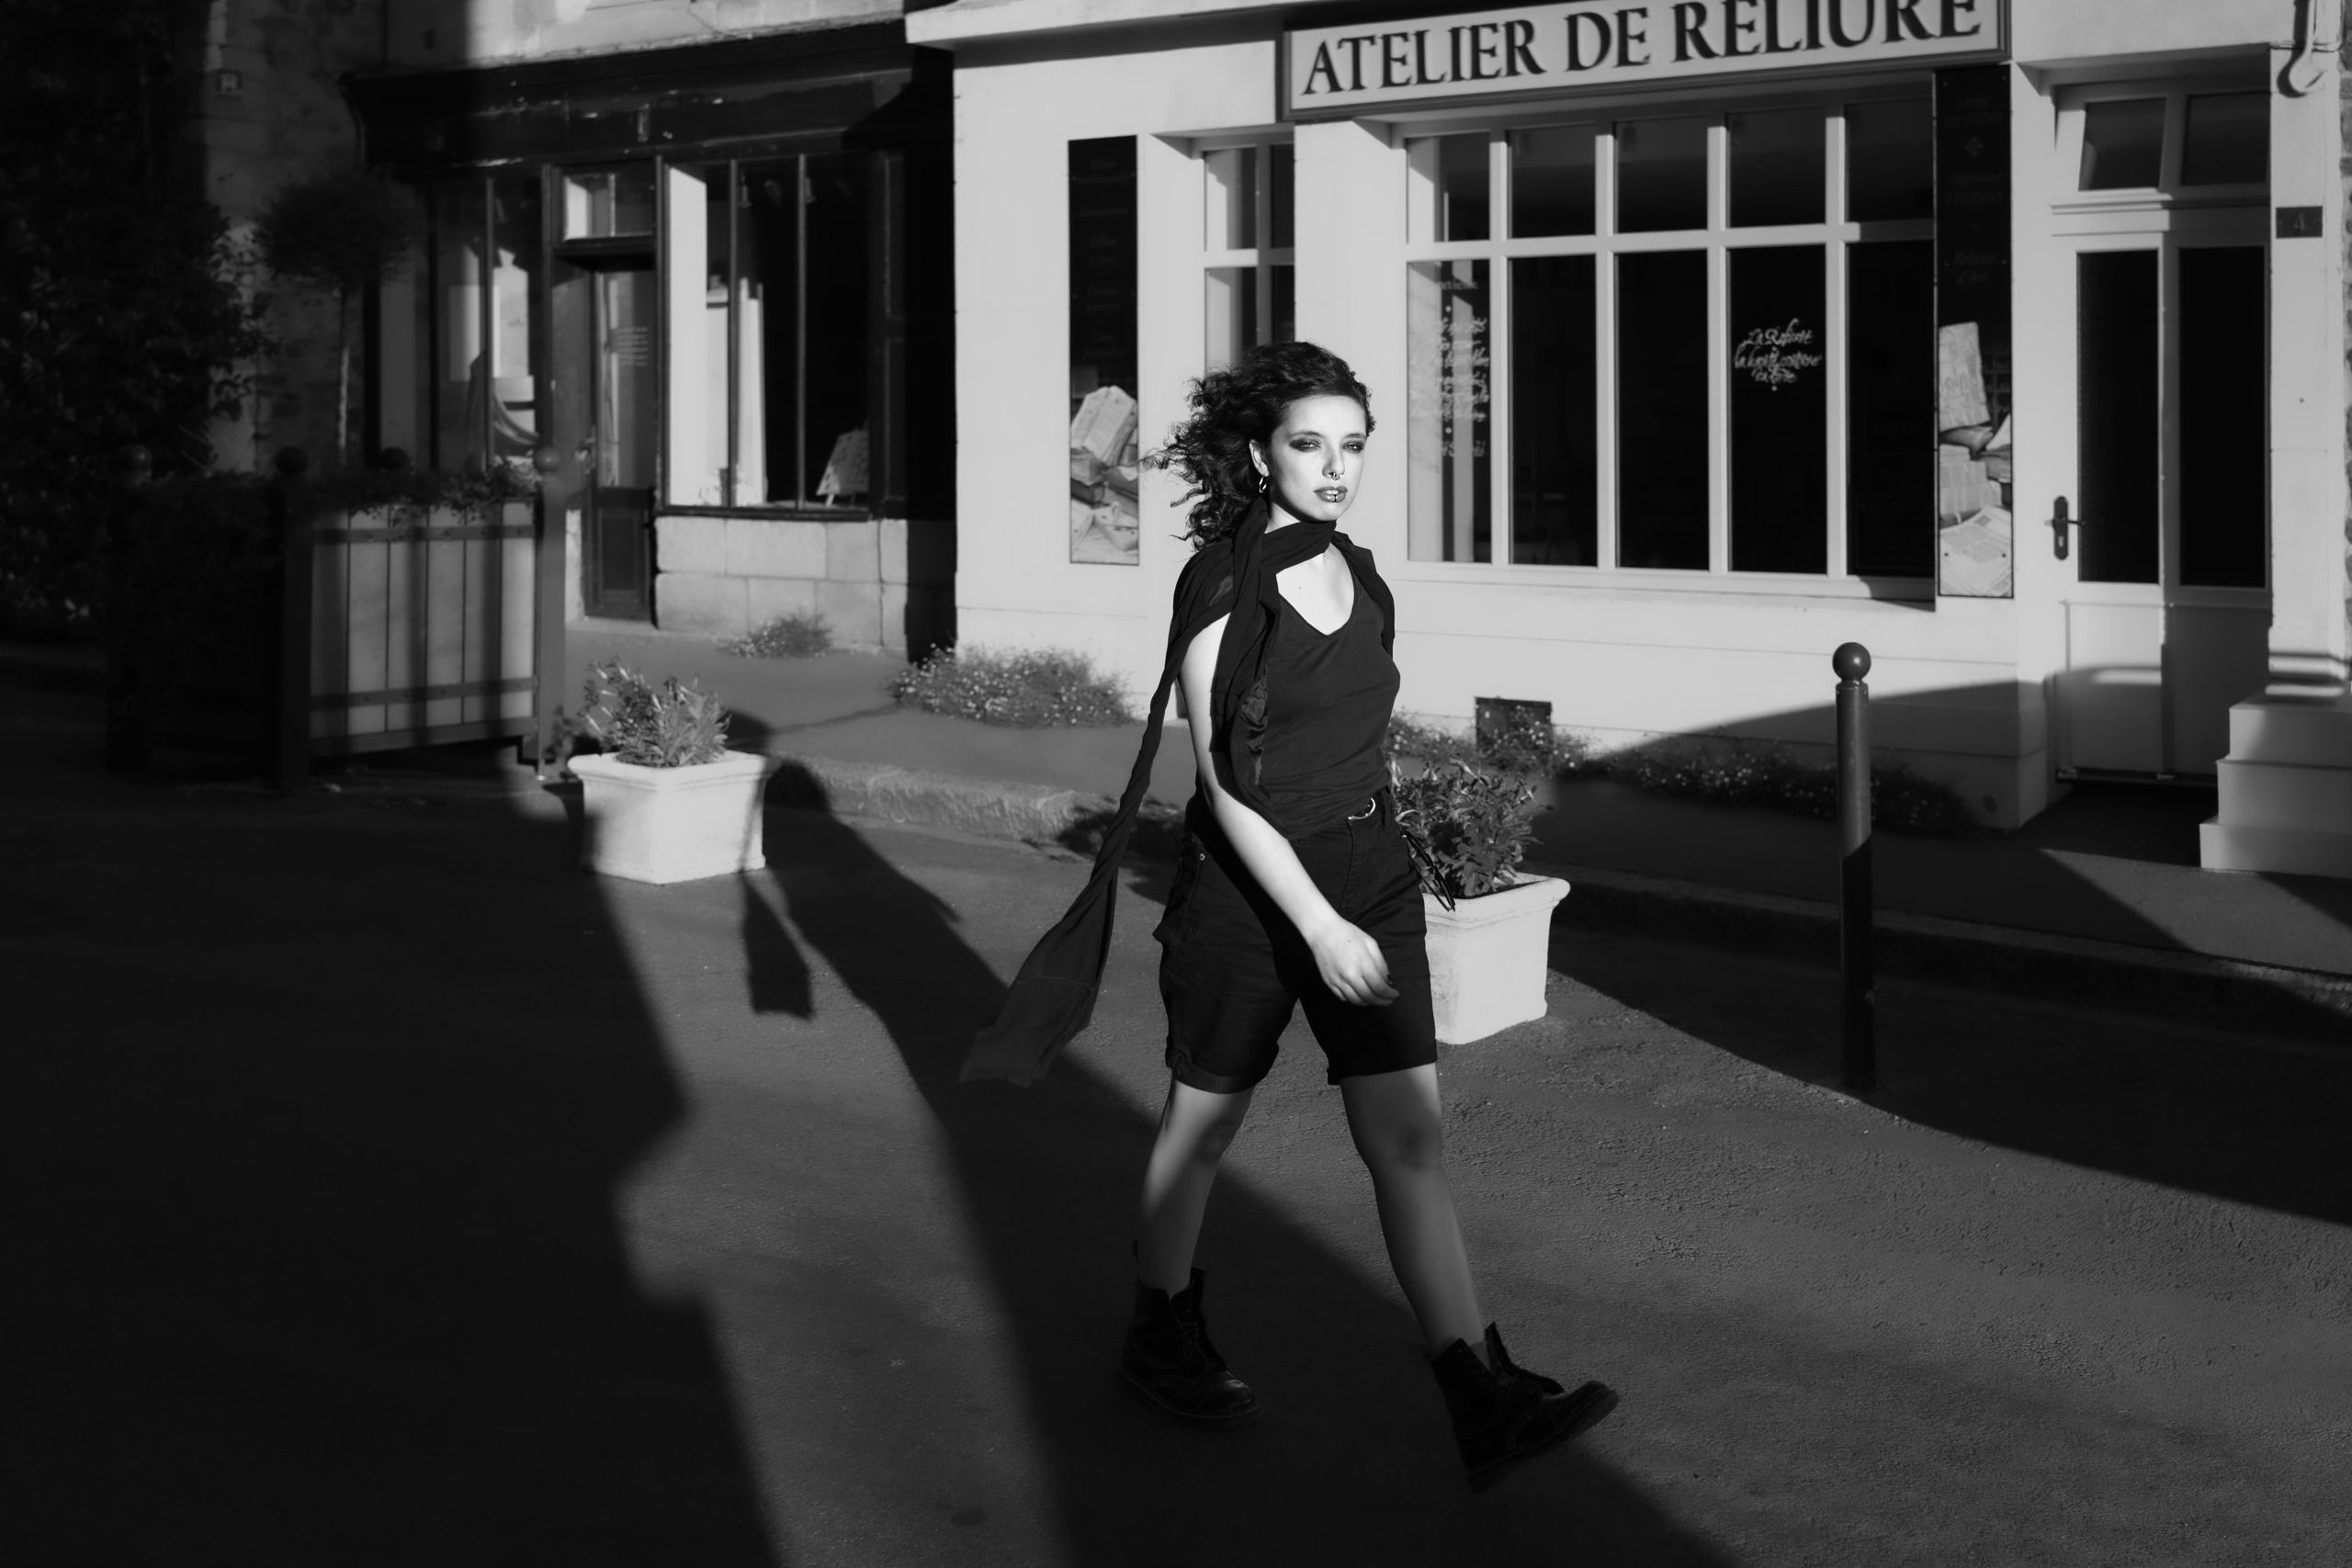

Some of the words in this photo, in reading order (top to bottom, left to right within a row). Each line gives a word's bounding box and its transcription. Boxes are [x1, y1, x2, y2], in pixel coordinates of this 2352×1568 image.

[1302, 19, 1548, 96] ATELIER
[1564, 6, 1651, 73] DE
[1670, 0, 1982, 62] RELIURE
